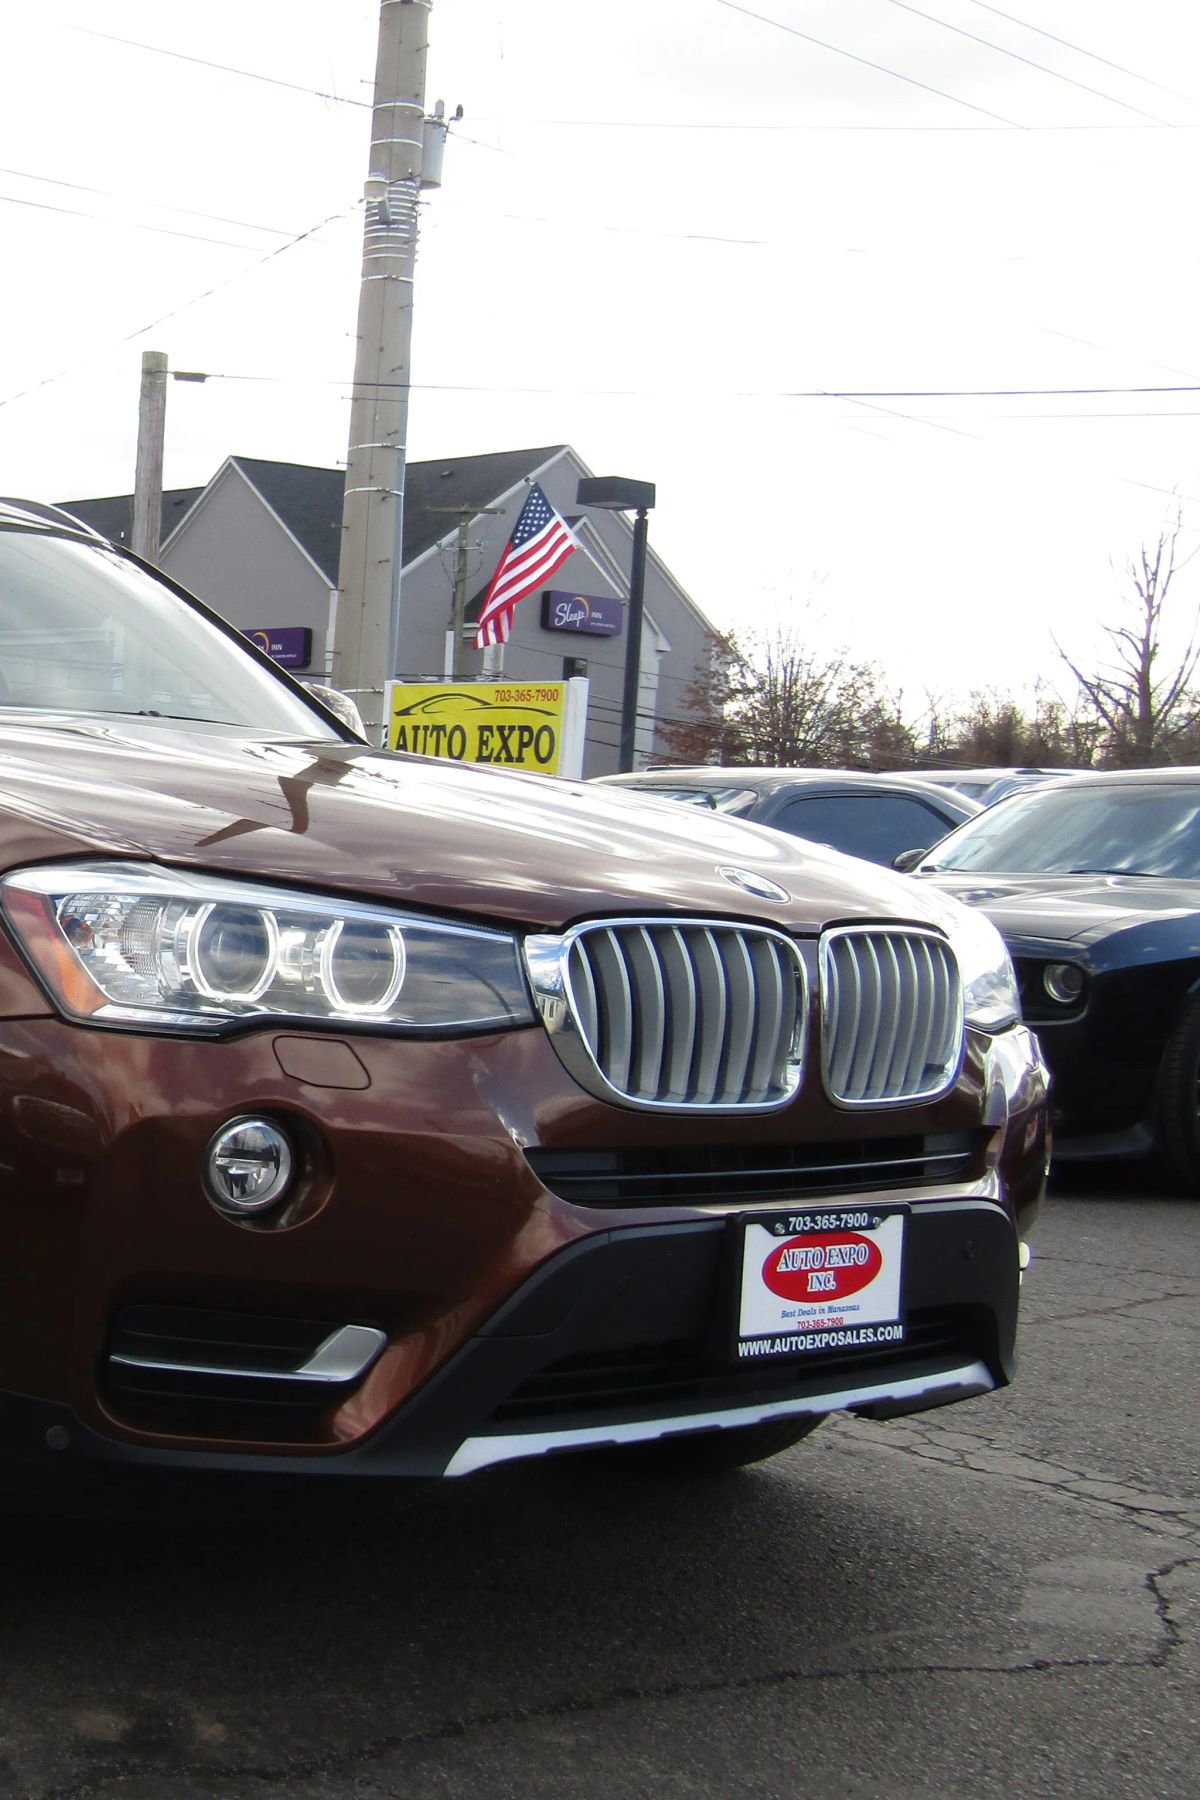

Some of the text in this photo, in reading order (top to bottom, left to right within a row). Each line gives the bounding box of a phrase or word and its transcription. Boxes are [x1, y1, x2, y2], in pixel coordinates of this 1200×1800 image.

[554, 602, 585, 628] Sleep
[494, 688, 559, 703] 703-365-7900
[395, 724, 467, 761] AUTO
[475, 724, 556, 765] EXPO
[788, 1212, 869, 1232] 703-365-7900
[776, 1243, 869, 1272] AUTO EXPO
[807, 1271, 836, 1292] INC.
[781, 1310, 796, 1318] Best
[797, 1307, 817, 1317] Deals
[818, 1305, 826, 1315] in
[797, 1317, 844, 1329] 703-365-7900
[738, 1325, 903, 1358] WWW.AUTOEXPOSALES.COM
